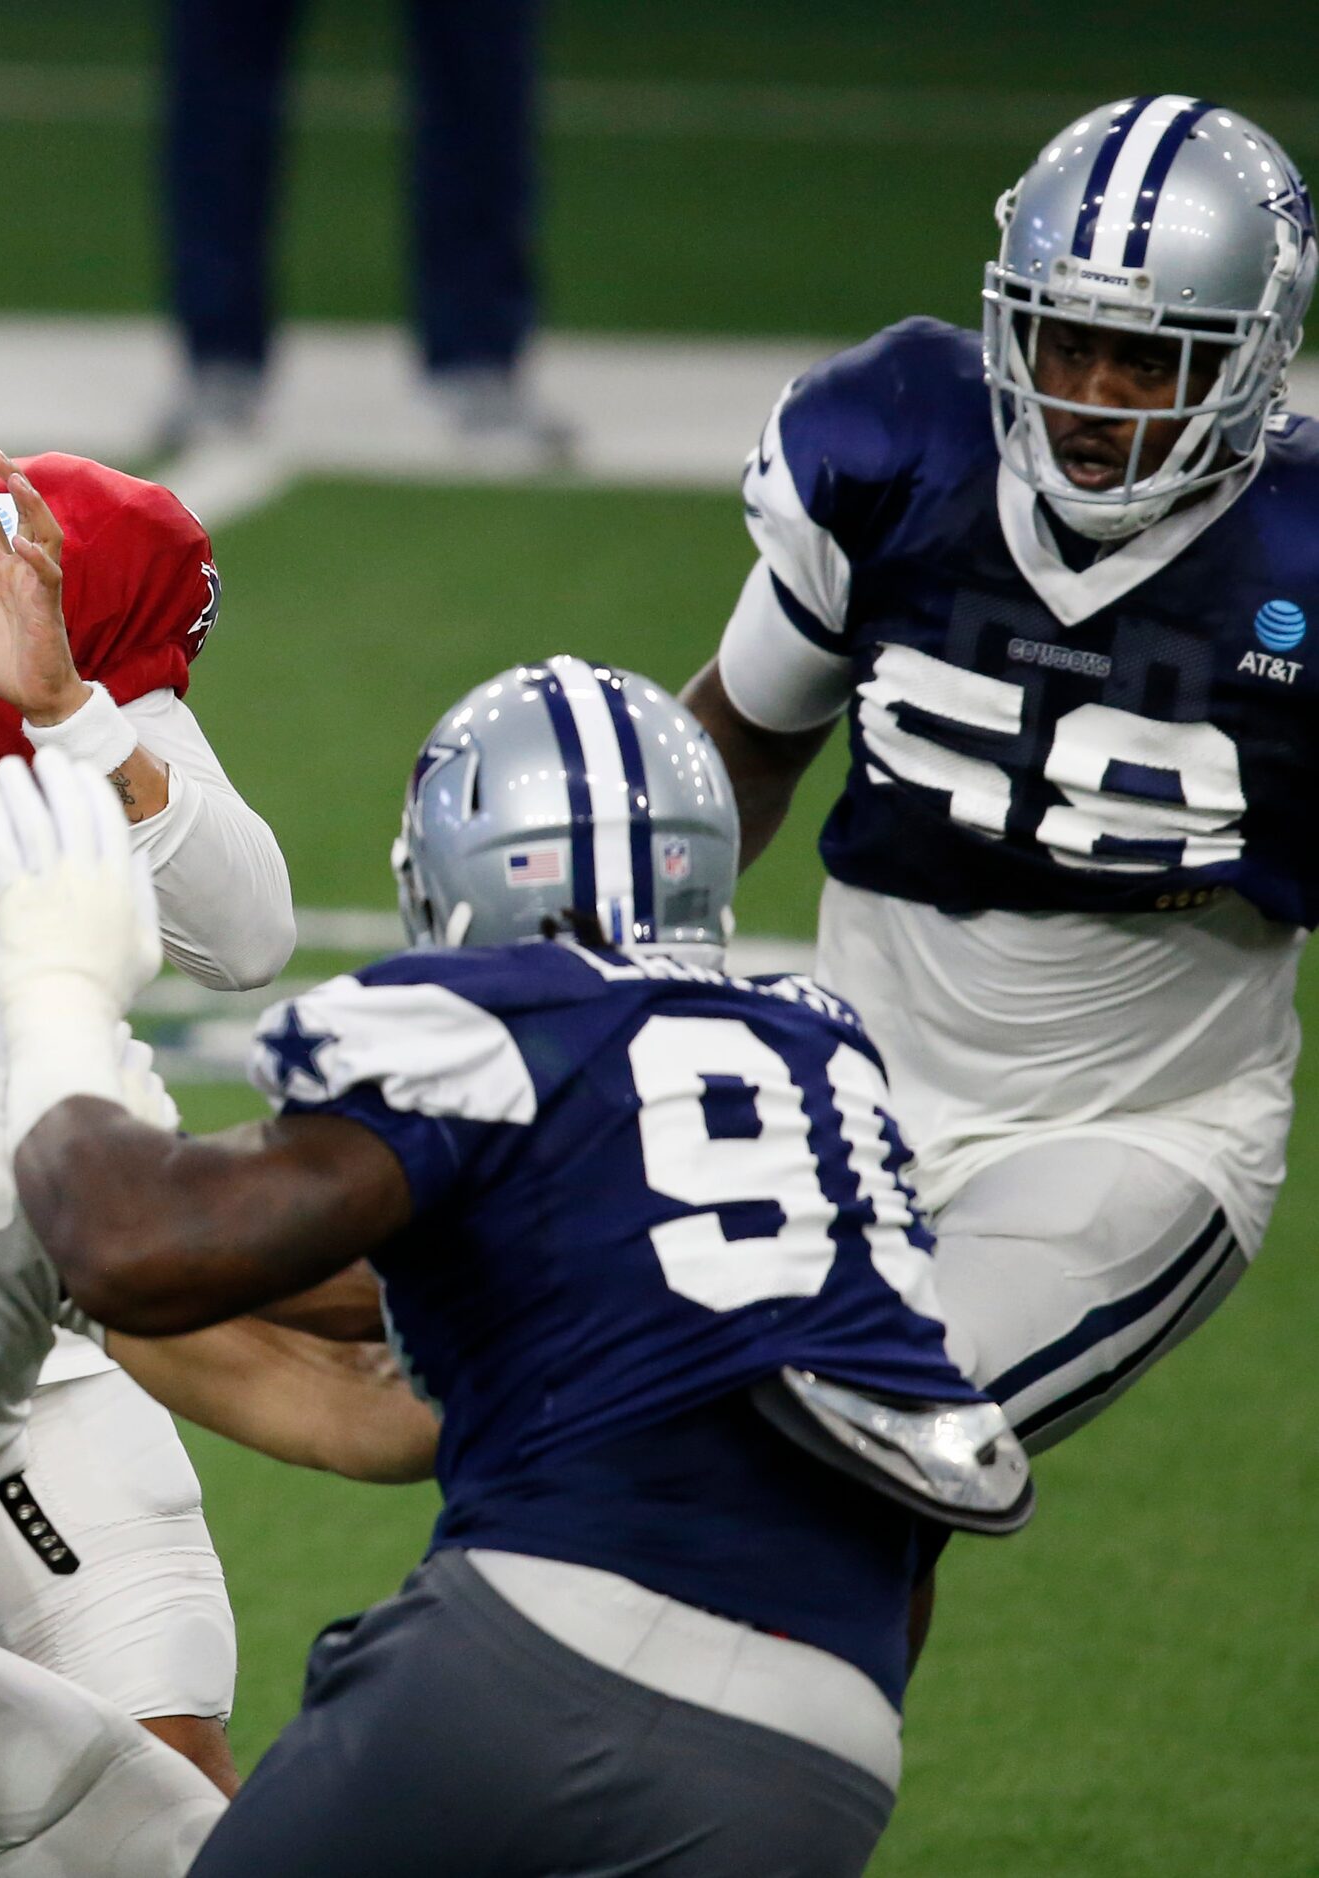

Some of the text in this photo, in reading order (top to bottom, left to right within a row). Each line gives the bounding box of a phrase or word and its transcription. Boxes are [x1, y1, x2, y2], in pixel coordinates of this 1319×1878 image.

[1007, 638, 1112, 677] COWBOYS
[1237, 650, 1304, 683] AT&T
[856, 641, 1247, 873] 58
[628, 1015, 944, 1321] 90
